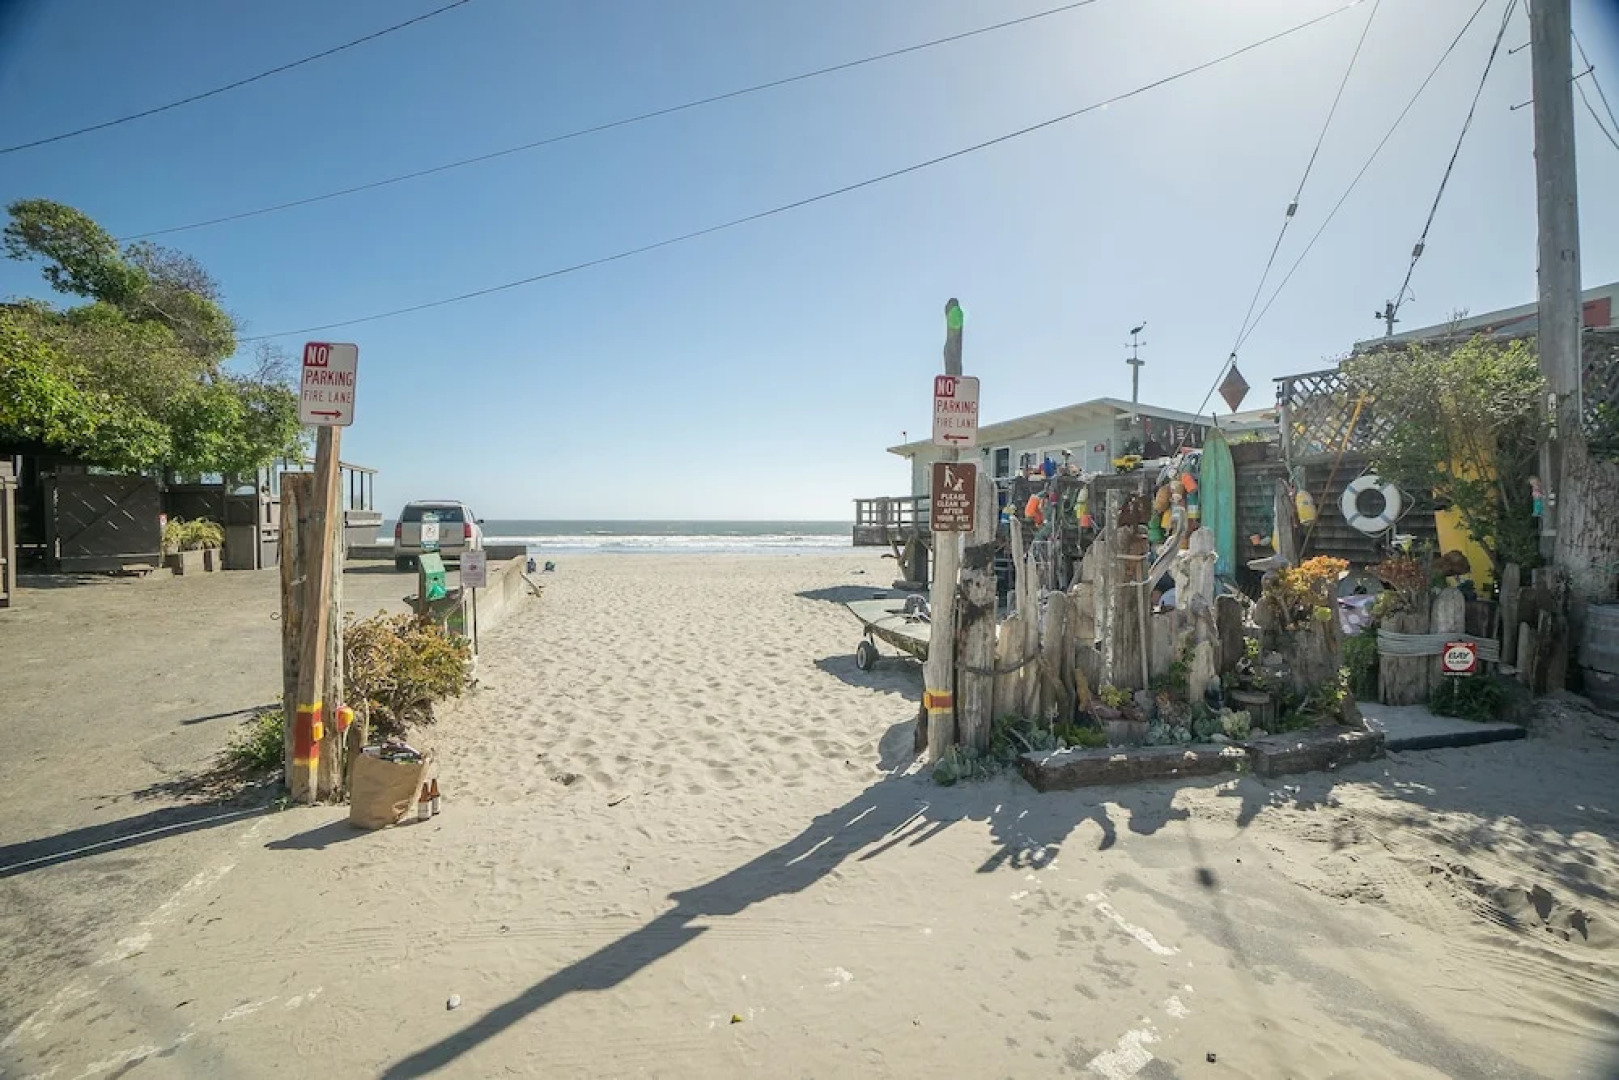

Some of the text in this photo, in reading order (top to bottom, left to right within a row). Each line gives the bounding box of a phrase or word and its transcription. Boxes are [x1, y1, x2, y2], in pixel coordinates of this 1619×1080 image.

[307, 346, 327, 364] NO
[305, 370, 352, 387] PARKING
[937, 378, 953, 395] NO
[304, 389, 351, 403] FIRE LANE
[937, 400, 977, 413] PARKING
[937, 417, 975, 428] FIRE LANE
